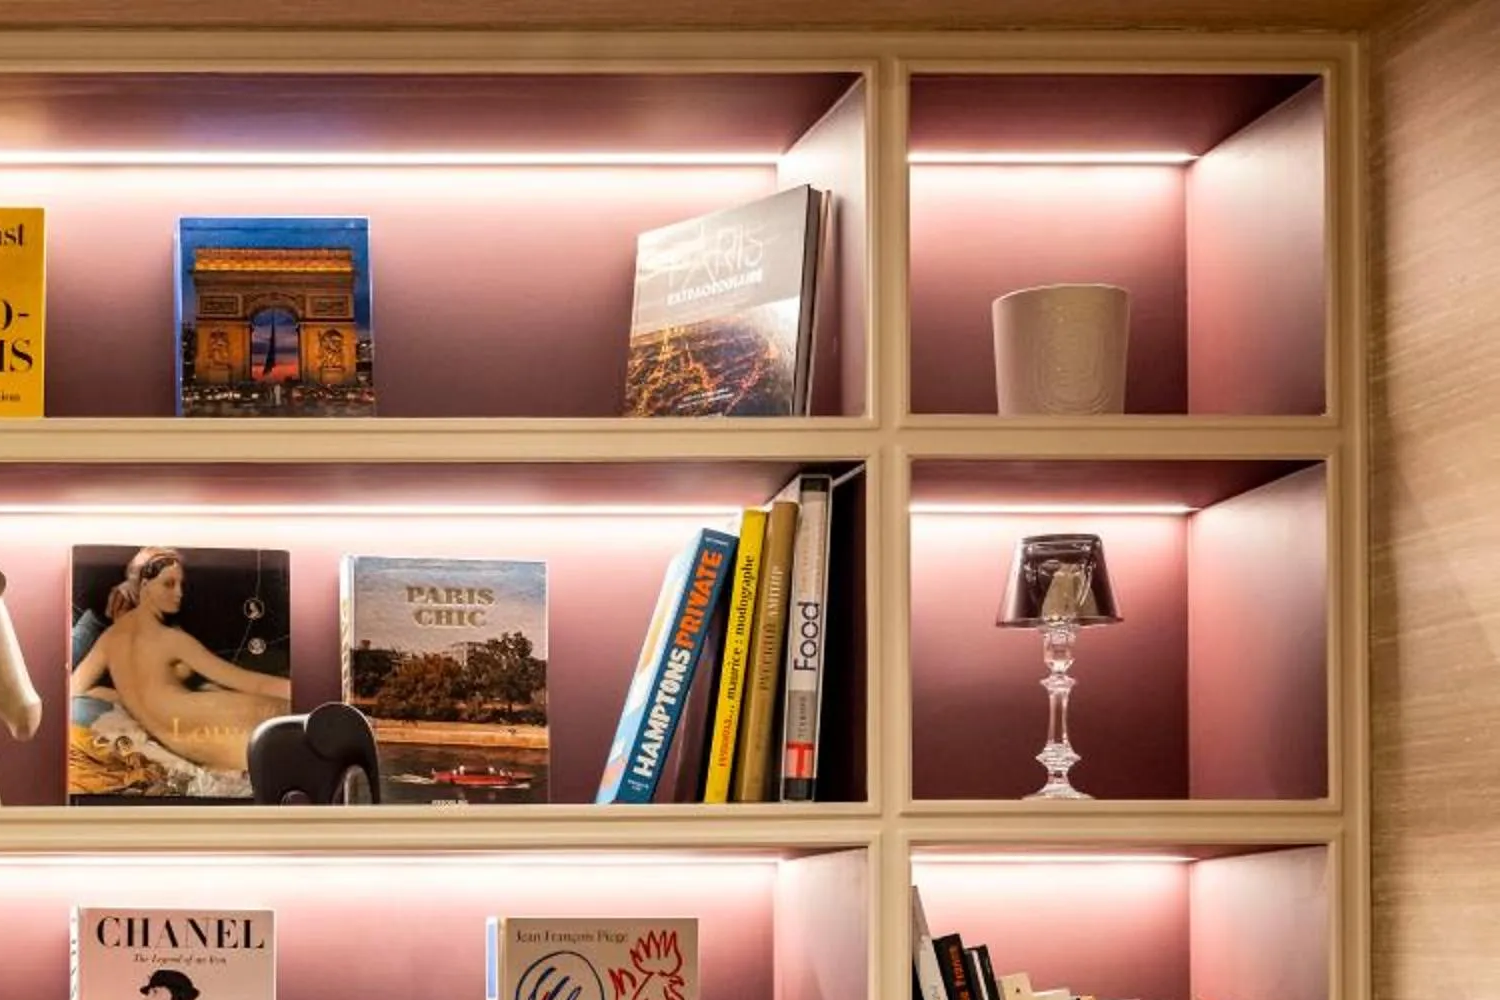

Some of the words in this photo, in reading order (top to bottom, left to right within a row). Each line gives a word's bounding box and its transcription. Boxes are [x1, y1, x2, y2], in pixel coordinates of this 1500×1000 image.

[405, 586, 495, 605] PARIS
[413, 609, 487, 626] CHIC
[736, 555, 756, 635] modographe
[794, 601, 820, 671] Food
[634, 648, 692, 777] HAMPTONS
[676, 549, 722, 649] PRIVATE
[97, 916, 265, 949] CHANEL
